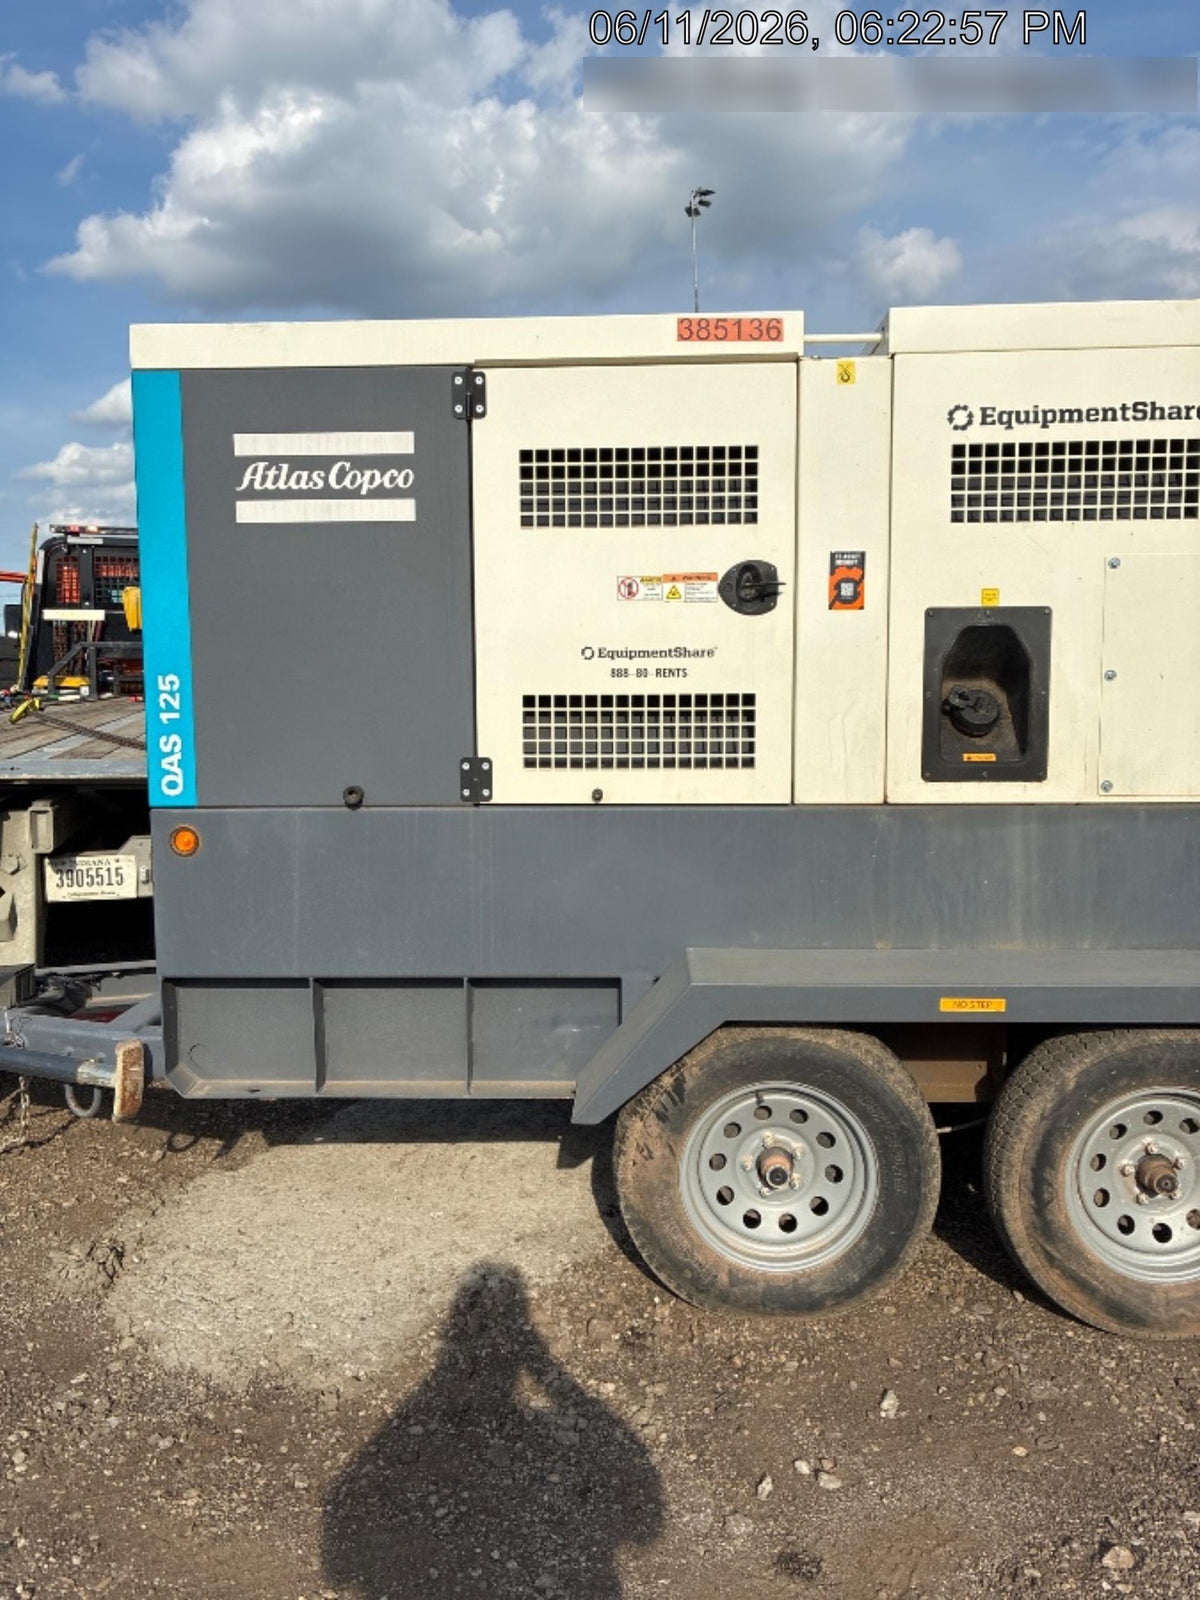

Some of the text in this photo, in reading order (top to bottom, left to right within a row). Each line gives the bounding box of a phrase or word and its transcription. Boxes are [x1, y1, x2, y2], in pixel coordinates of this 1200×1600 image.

[679, 318, 781, 341] 385136
[235, 460, 415, 496] Atlas Copco
[597, 646, 716, 661] EquipmentShare
[157, 673, 185, 797] QAS 125
[56, 867, 124, 888] 3905515
[953, 1000, 968, 1009] NO
